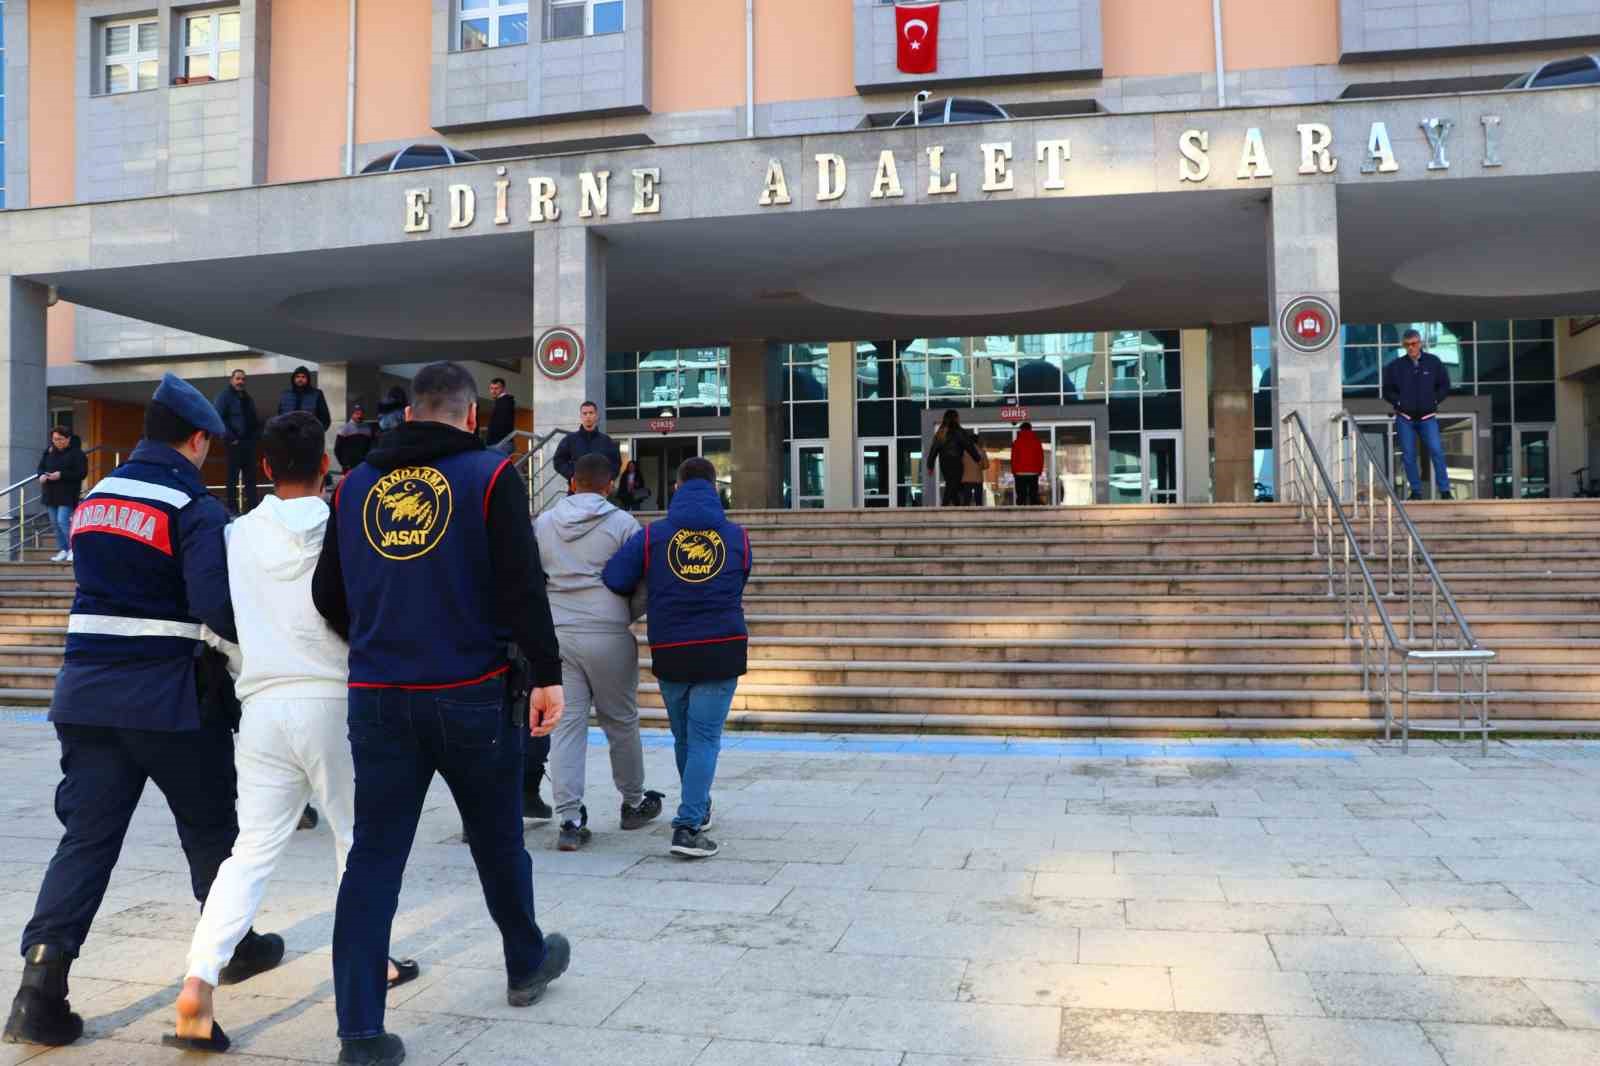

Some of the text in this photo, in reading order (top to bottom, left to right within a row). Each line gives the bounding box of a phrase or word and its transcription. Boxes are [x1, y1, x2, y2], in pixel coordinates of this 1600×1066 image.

[404, 113, 1504, 233] EDİRNE ADALET SARAYI
[375, 468, 447, 498] JANDARMA
[73, 504, 157, 540] ANDARMA
[381, 530, 430, 547] JASAT
[680, 564, 712, 575] JASAT
